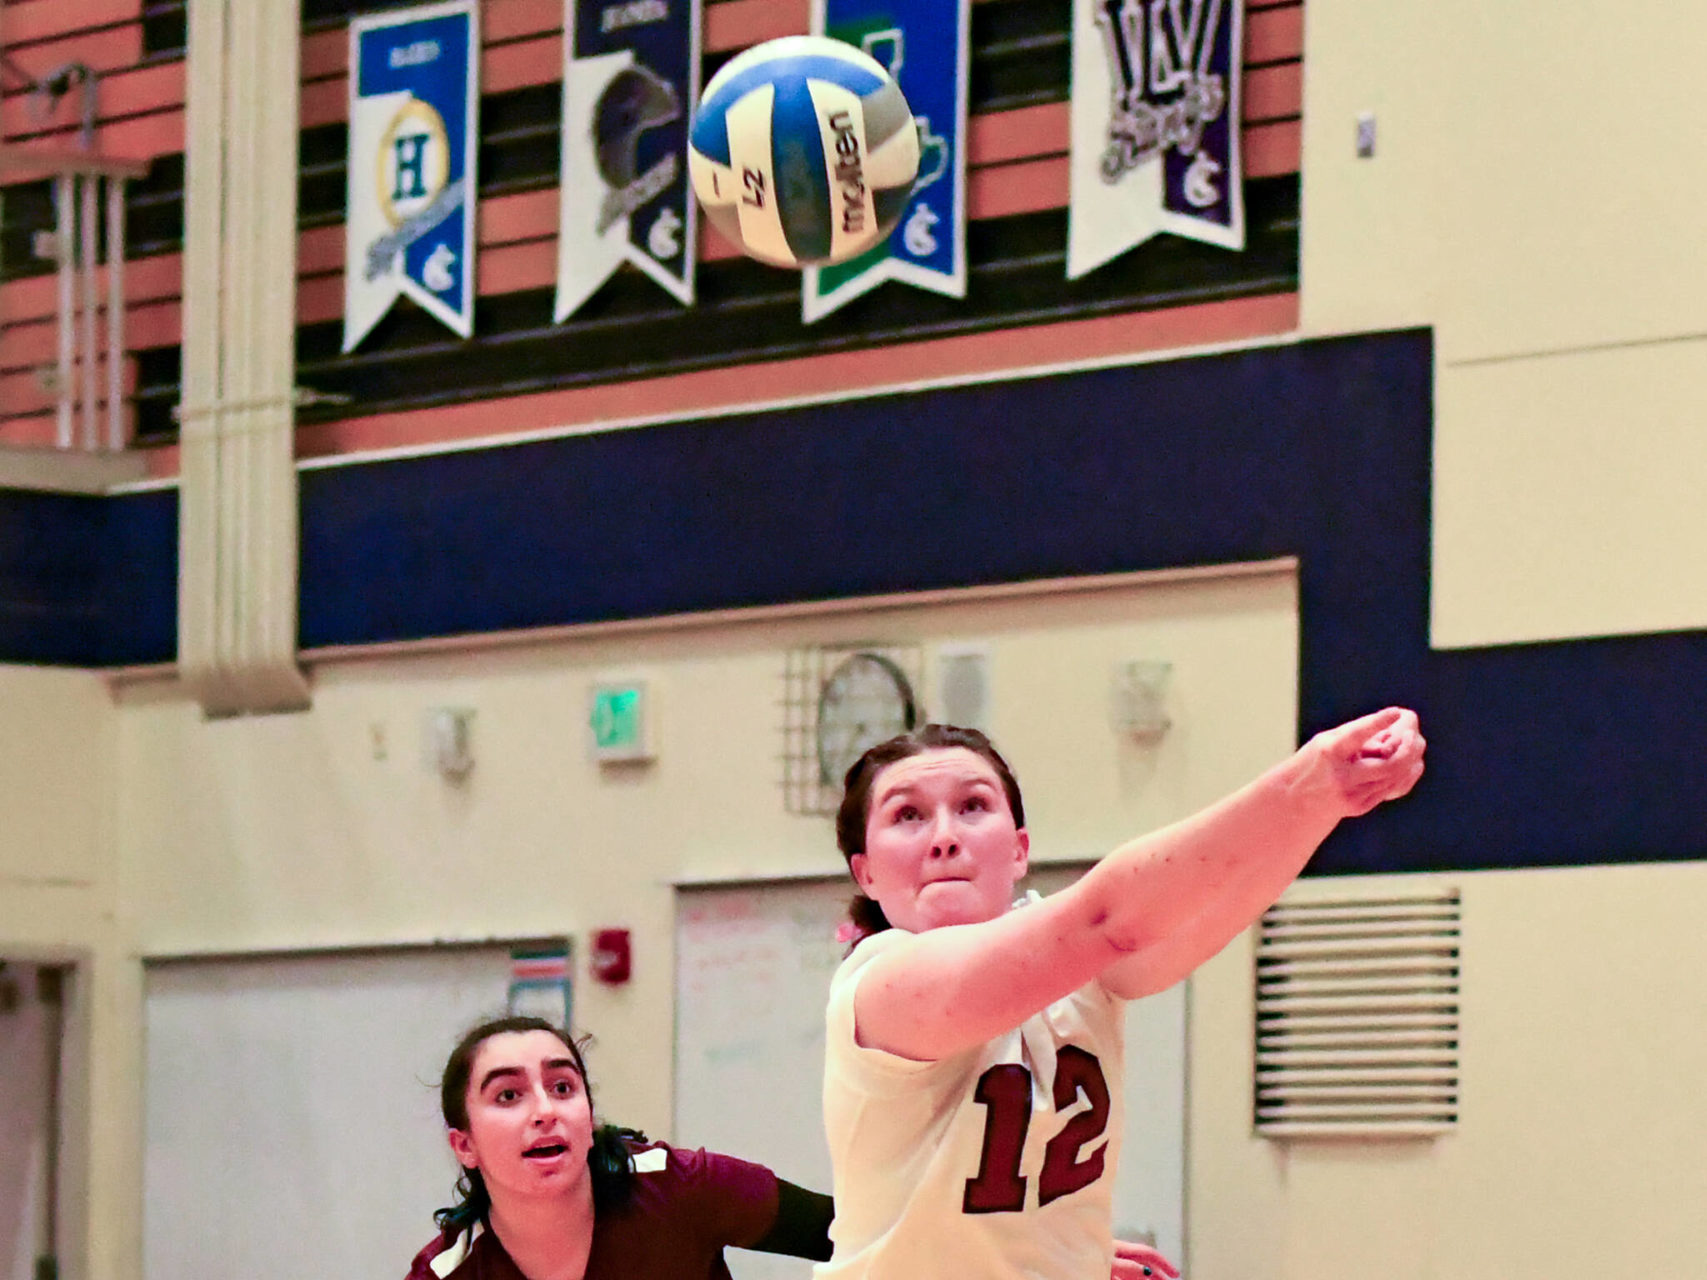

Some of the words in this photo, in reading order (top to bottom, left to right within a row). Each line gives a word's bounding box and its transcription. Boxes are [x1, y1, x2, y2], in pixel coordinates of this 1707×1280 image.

[393, 134, 429, 200] H
[829, 110, 864, 233] molten
[962, 1044, 1110, 1213] 12
